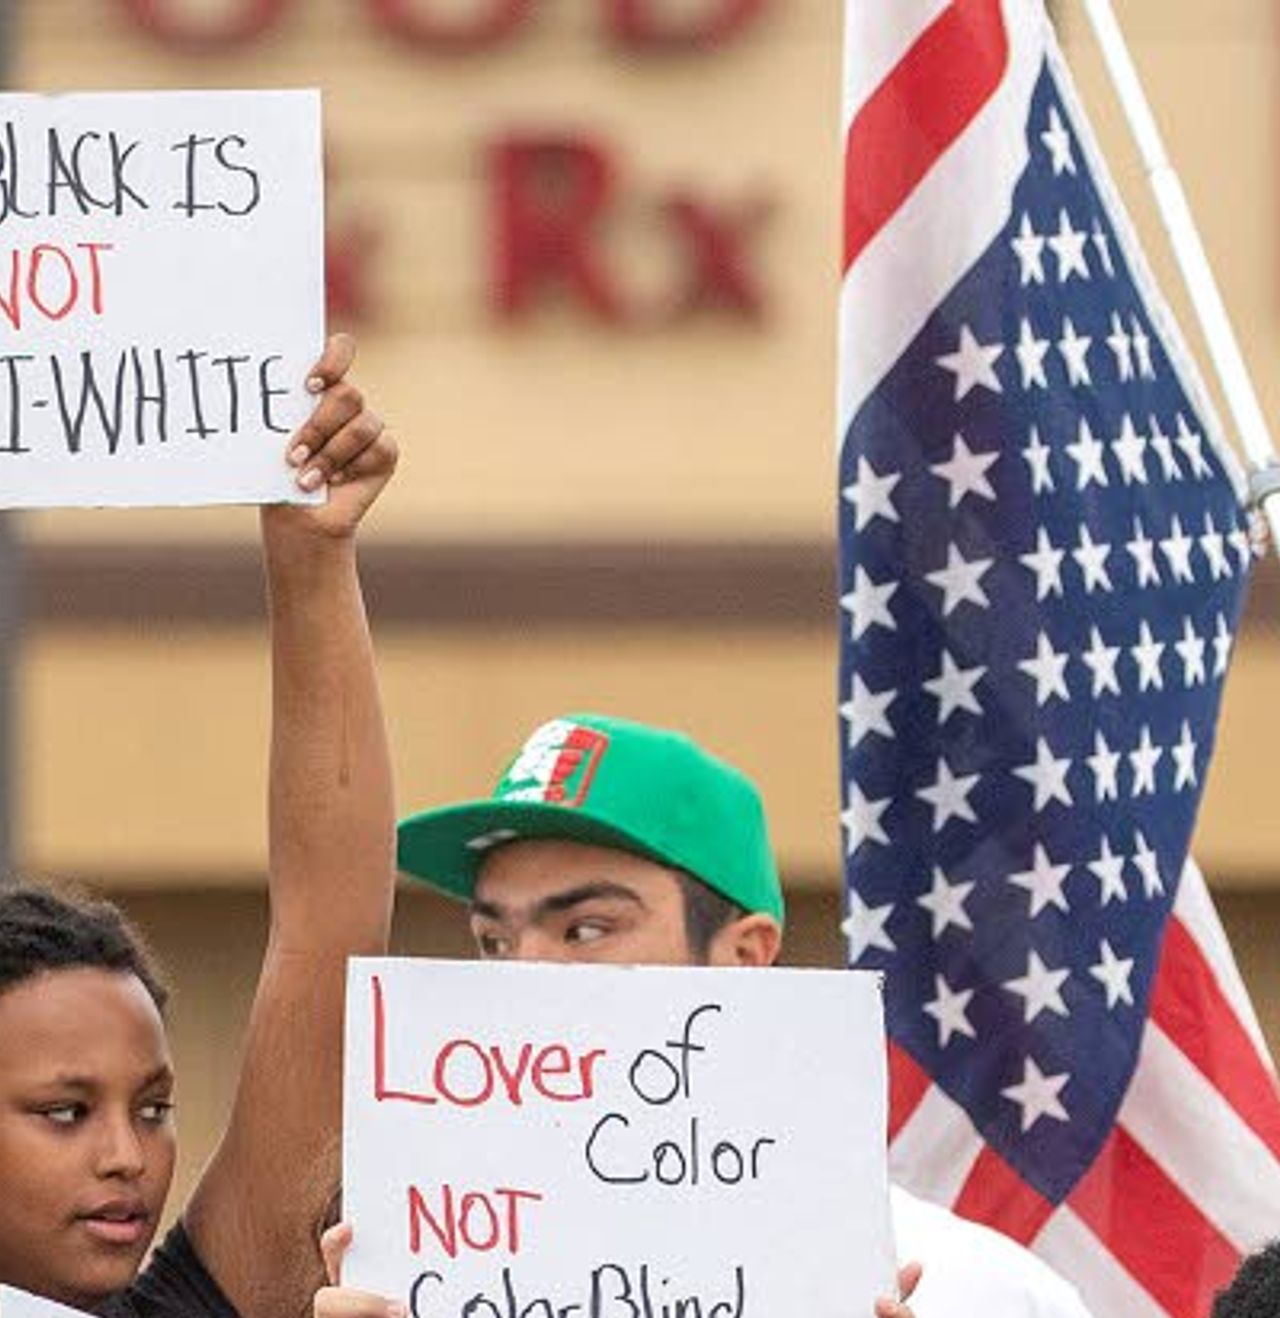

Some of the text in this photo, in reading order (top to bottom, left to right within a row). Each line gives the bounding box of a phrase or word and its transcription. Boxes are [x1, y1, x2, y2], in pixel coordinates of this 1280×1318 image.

[172, 134, 260, 218] IS
[371, 975, 722, 1107] Lover of
[585, 1112, 776, 1186] Color
[408, 1184, 542, 1259] NOT
